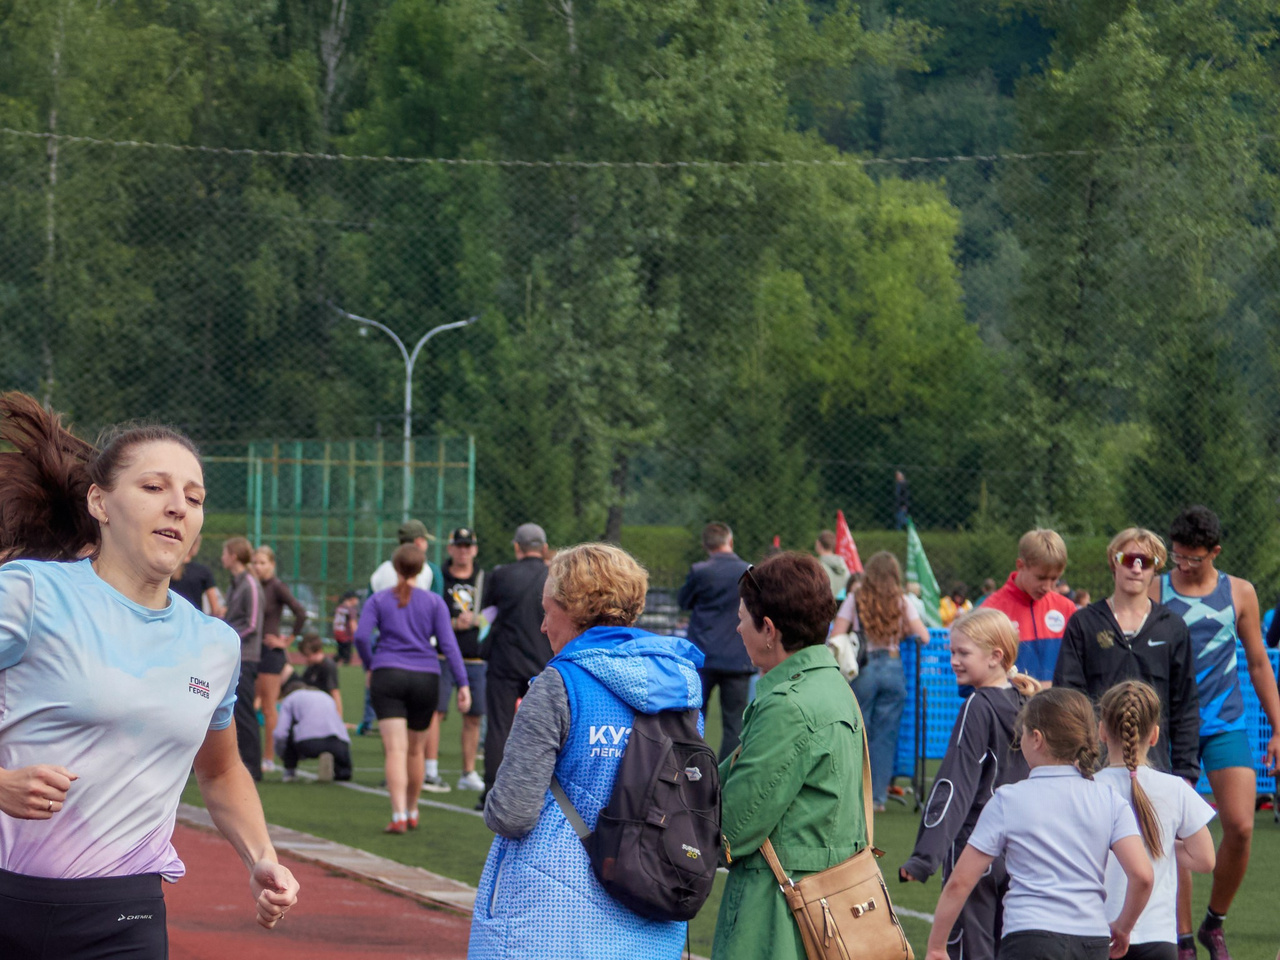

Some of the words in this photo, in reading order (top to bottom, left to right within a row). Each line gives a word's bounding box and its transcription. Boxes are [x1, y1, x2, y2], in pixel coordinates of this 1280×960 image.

[190, 676, 210, 688] ГОНКА
[188, 686, 210, 699] ГЕРОЕВ
[590, 747, 625, 758] ЛЕГК
[687, 851, 697, 859] 20
